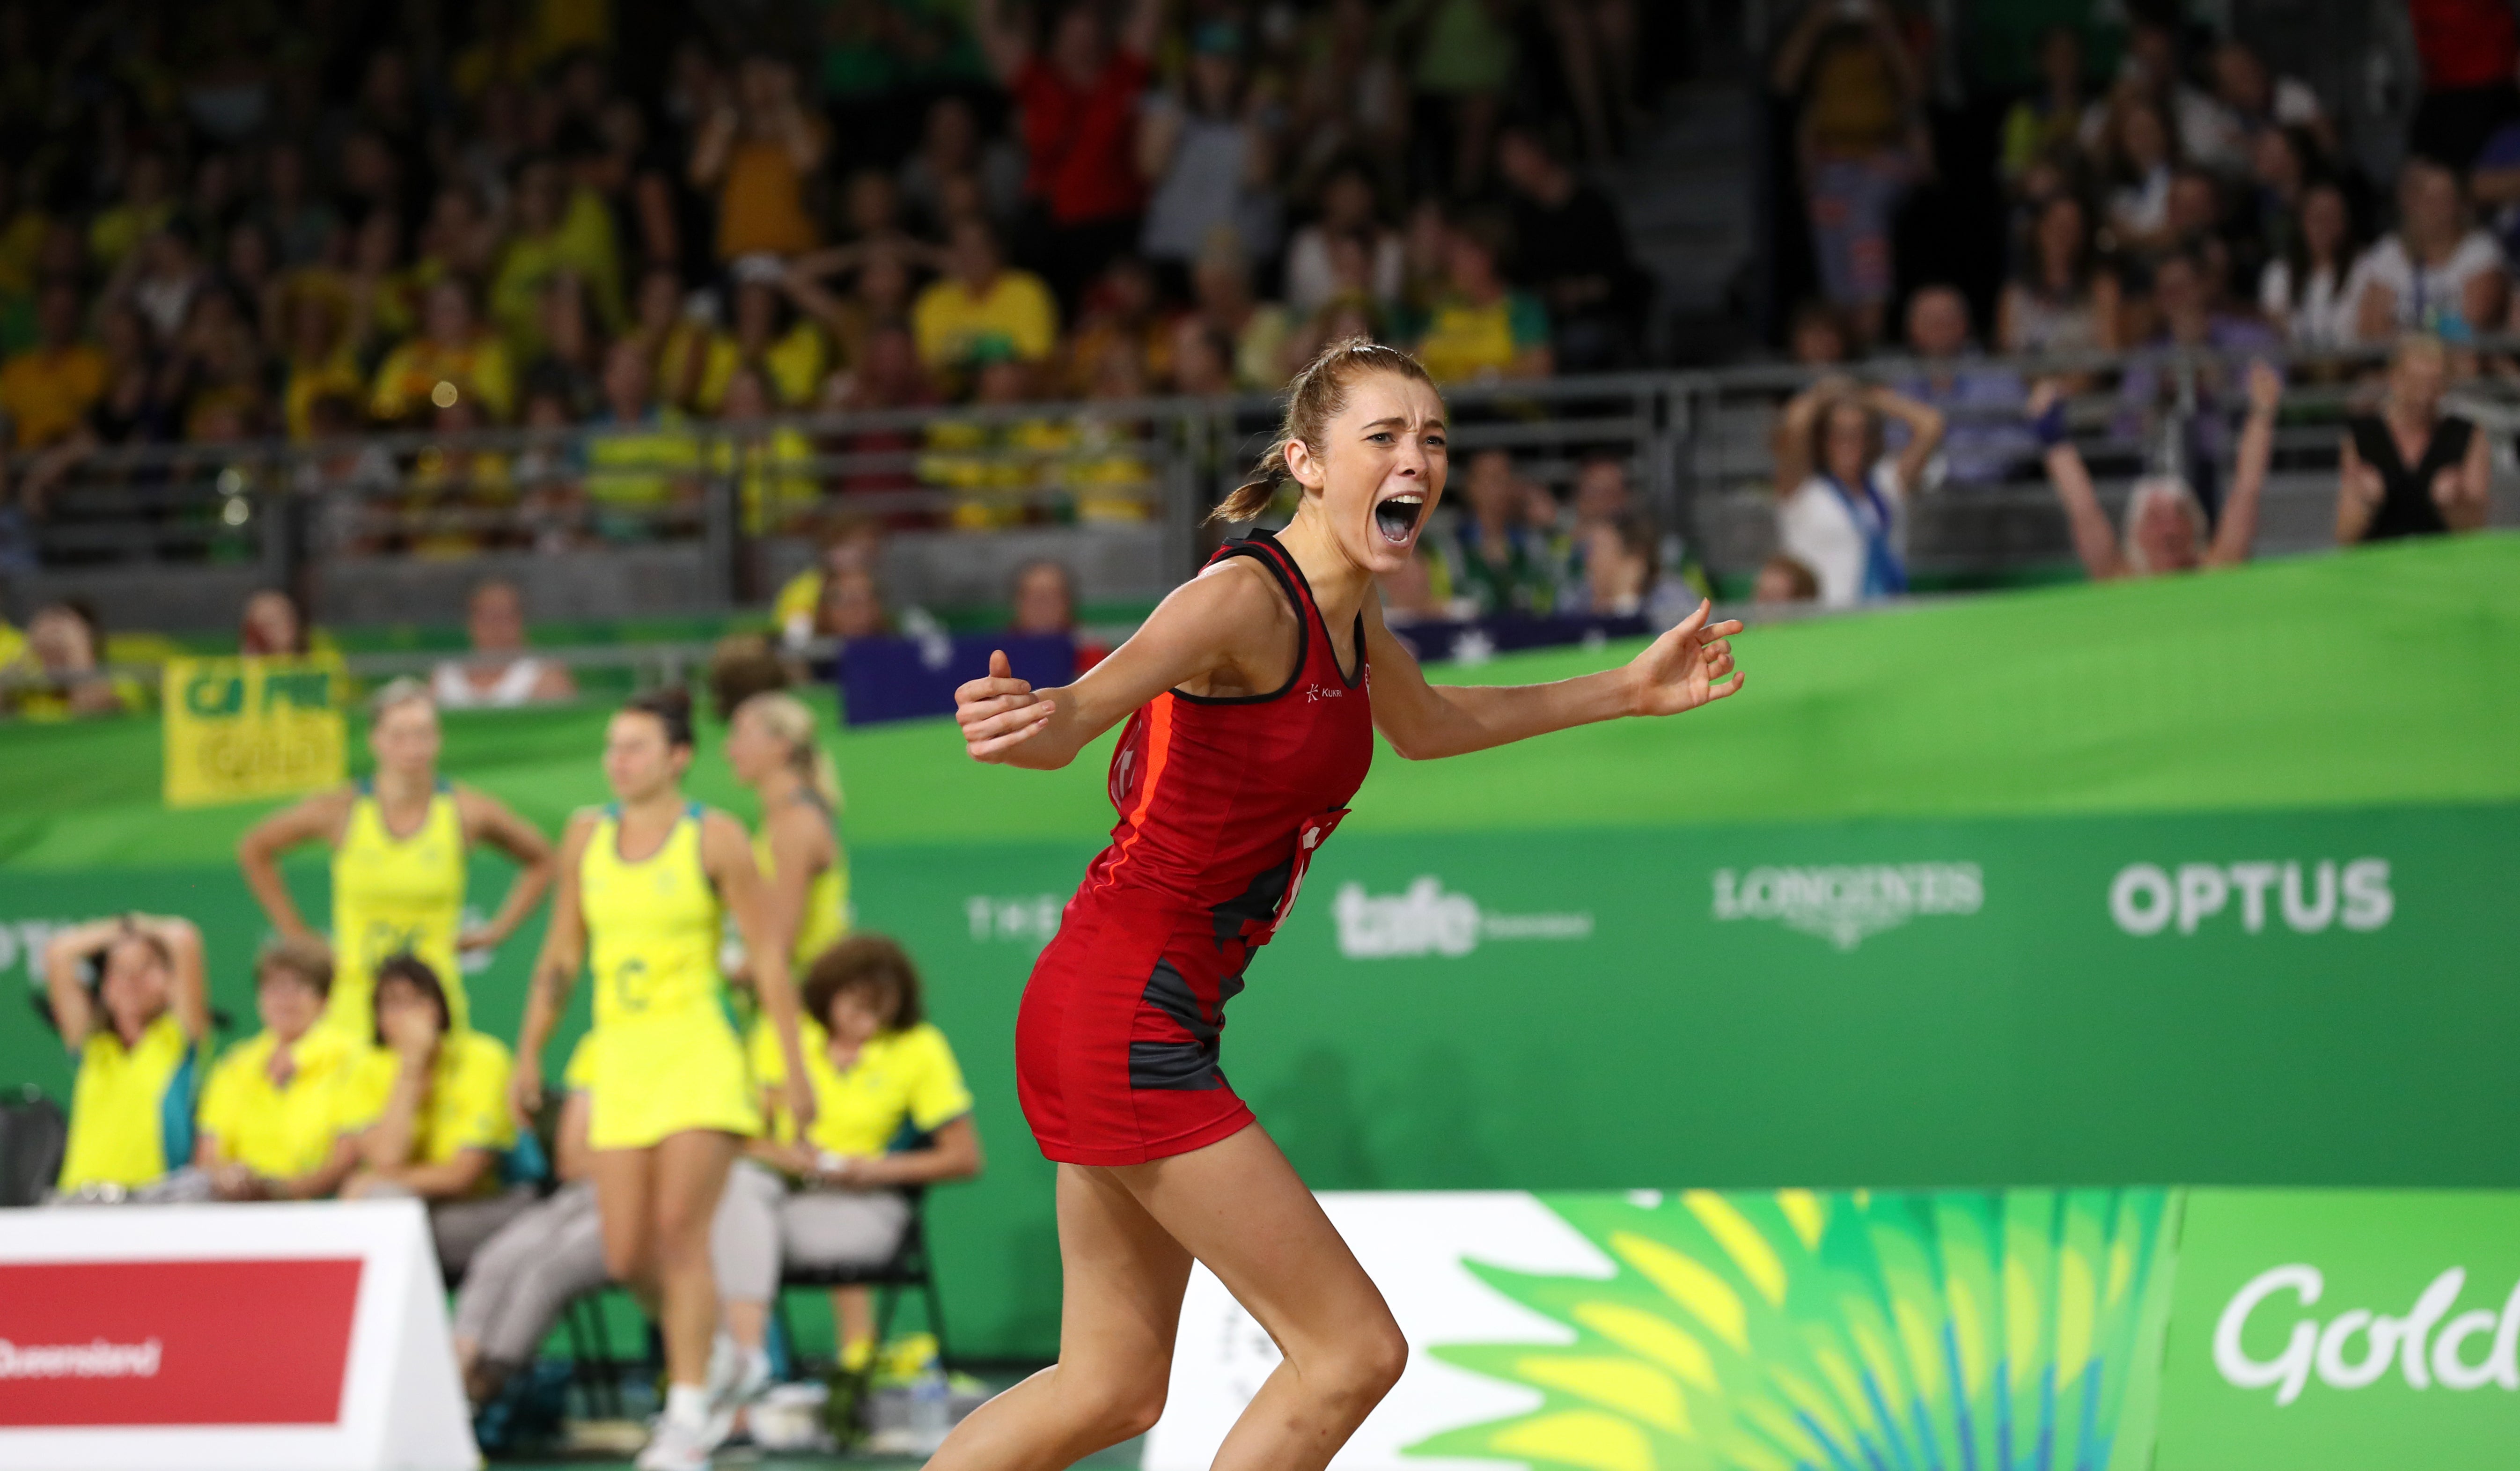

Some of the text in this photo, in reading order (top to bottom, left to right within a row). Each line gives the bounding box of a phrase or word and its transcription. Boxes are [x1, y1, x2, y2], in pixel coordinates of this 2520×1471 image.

[1322, 688, 1343, 697] KUKRI
[1332, 875, 1479, 957] tafe
[1712, 862, 1984, 920] LONGINES
[2110, 858, 2395, 935] OPTUS
[615, 955, 650, 1014] C
[2212, 1262, 2520, 1406] Gold
